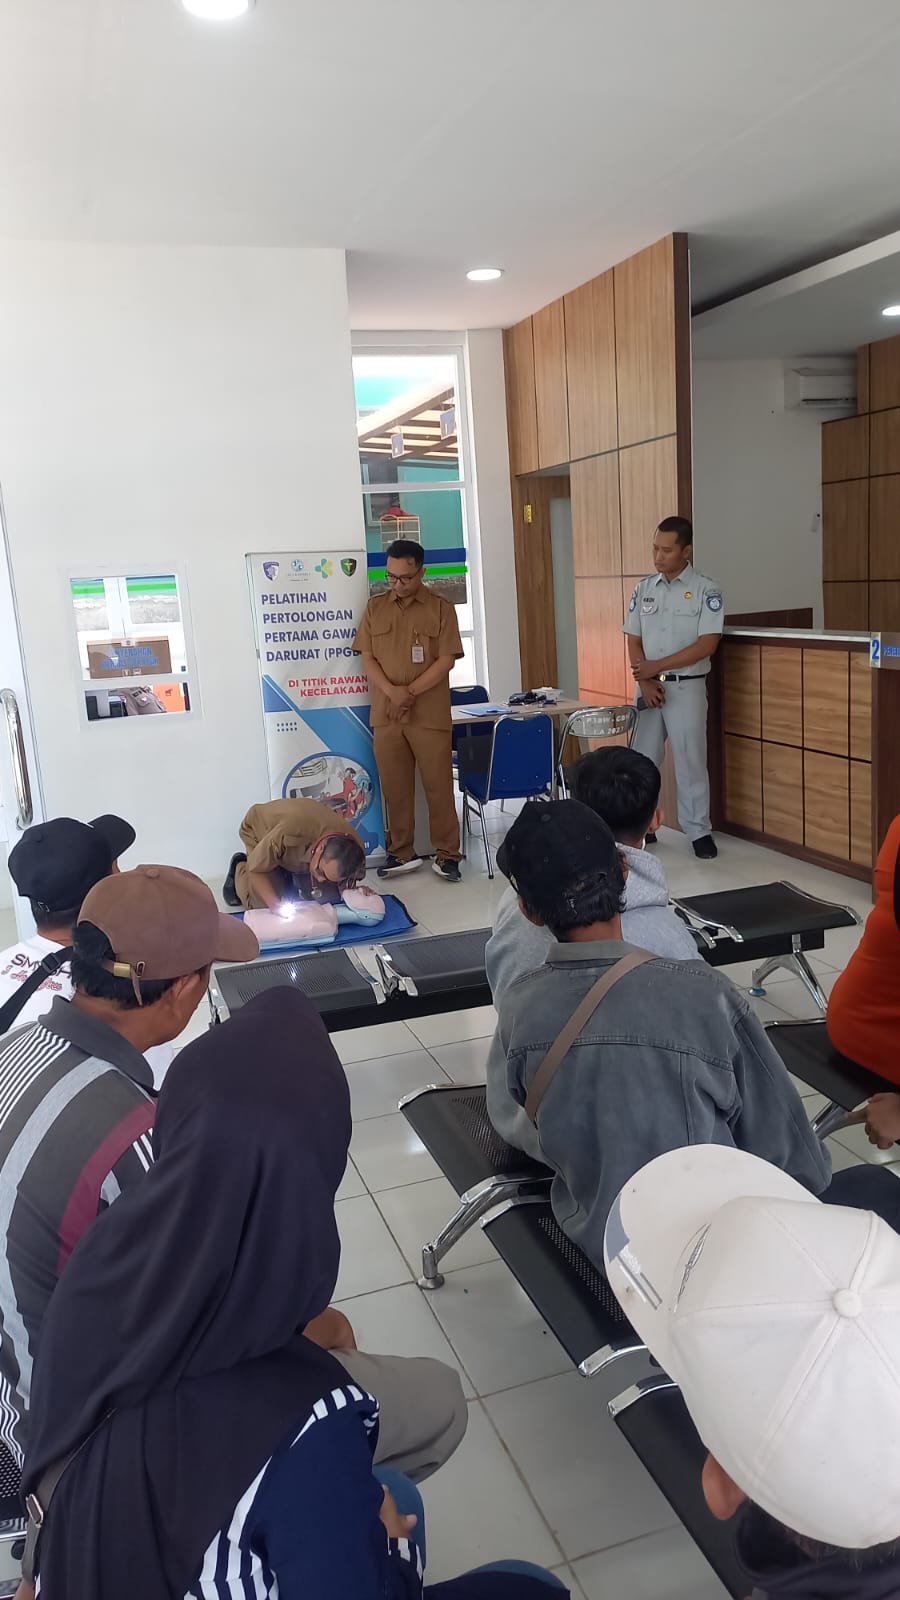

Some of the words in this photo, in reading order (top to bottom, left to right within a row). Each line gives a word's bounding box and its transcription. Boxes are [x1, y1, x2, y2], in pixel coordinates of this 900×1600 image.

[261, 591, 327, 605] PELATIHAN
[263, 609, 353, 624] PERTOLONGAN
[264, 629, 319, 643] PERTAMA
[322, 627, 357, 640] GAWA
[266, 648, 320, 662] DARURAT
[872, 639, 880, 659] 2
[288, 678, 299, 688] DI
[302, 676, 328, 687] TITIK
[330, 674, 368, 685] RAWAN
[300, 686, 369, 697] KECELAKAAN
